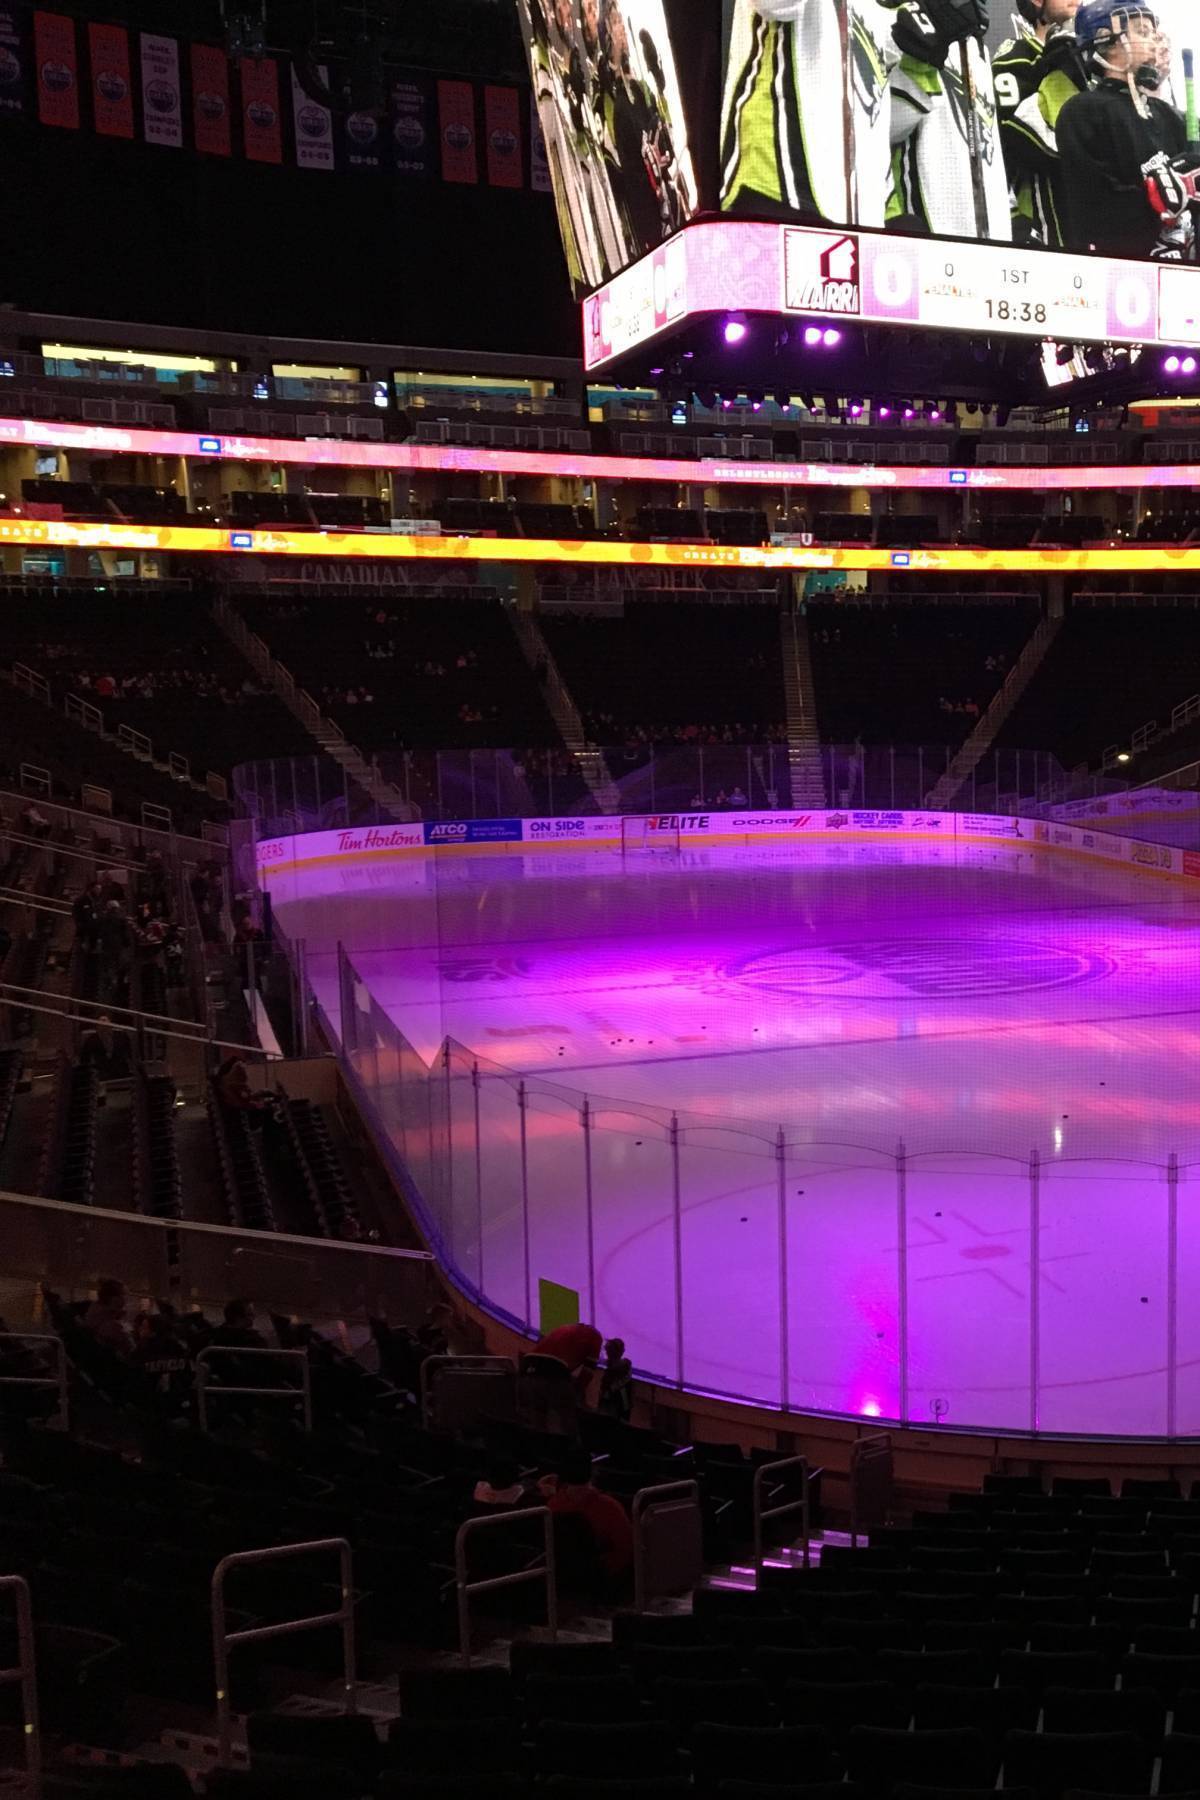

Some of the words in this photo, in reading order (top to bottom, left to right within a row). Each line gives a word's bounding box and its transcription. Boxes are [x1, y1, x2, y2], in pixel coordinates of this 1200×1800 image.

[1002, 269, 1029, 284] 1ST
[985, 299, 1047, 323] 18:38
[301, 562, 410, 586] CANADIAN
[430, 823, 468, 835] ATCO
[530, 821, 551, 832] ON
[338, 831, 362, 851] Tim
[364, 829, 422, 848] Hortons
